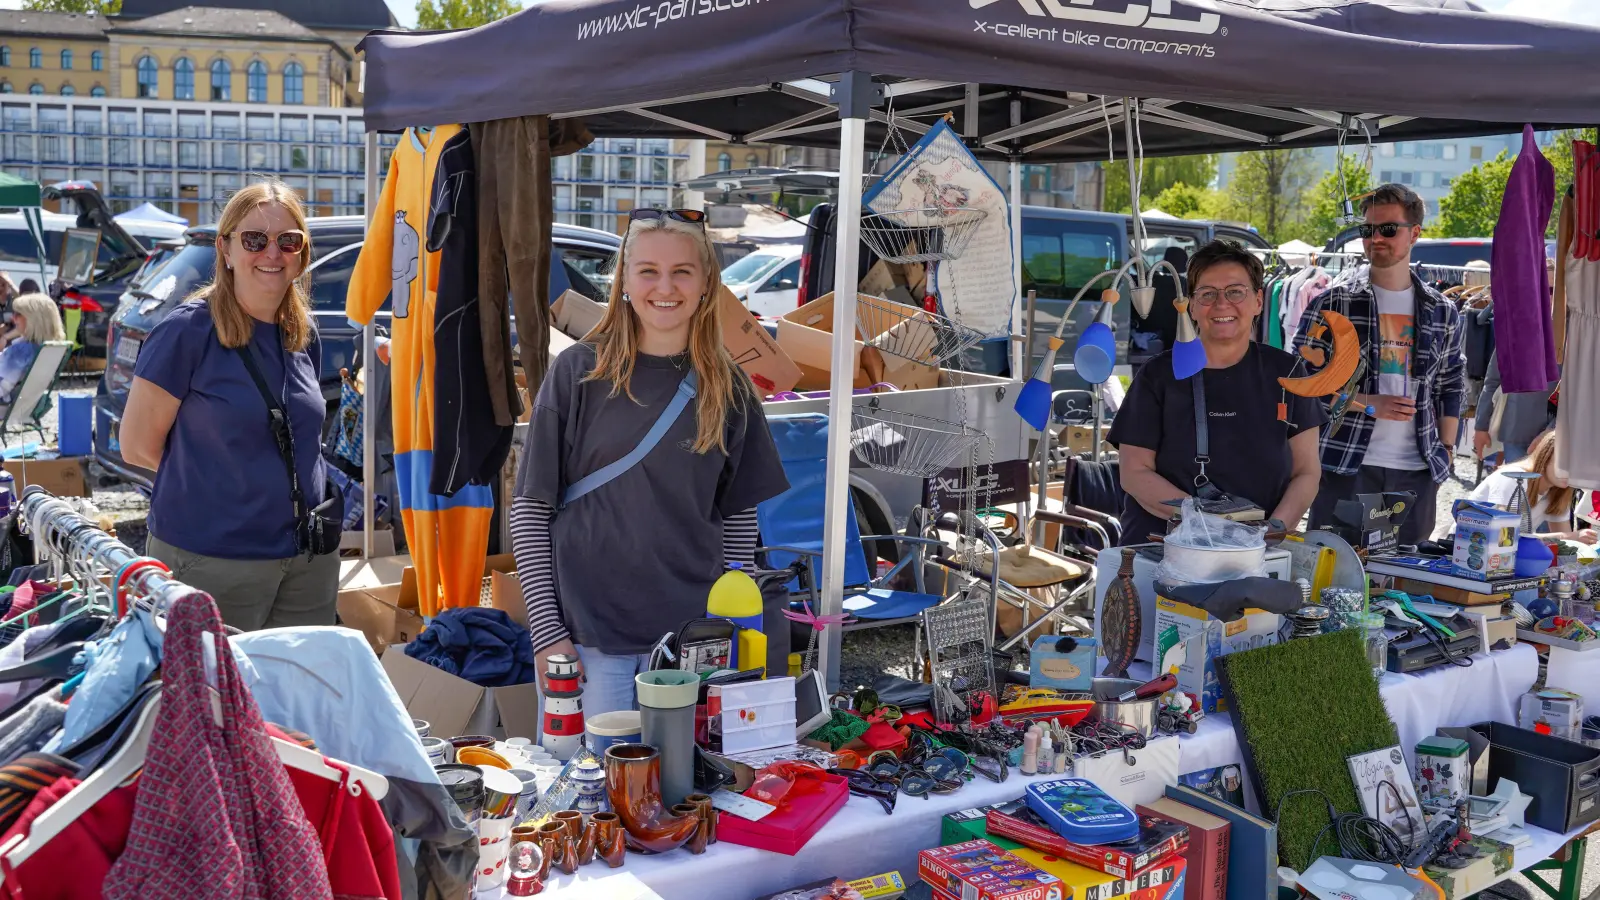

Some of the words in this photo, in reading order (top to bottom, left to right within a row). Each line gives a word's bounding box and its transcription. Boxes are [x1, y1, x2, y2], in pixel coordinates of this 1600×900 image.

[577, 0, 770, 40] www.xlc-parts.co
[973, 20, 1058, 42] x-cellent
[1062, 30, 1100, 46] bike
[1103, 36, 1216, 58] components
[1355, 757, 1385, 784] Yoga
[1036, 780, 1092, 794] SCARE
[921, 857, 948, 880] BINGO
[1215, 848, 1223, 873] Sagen
